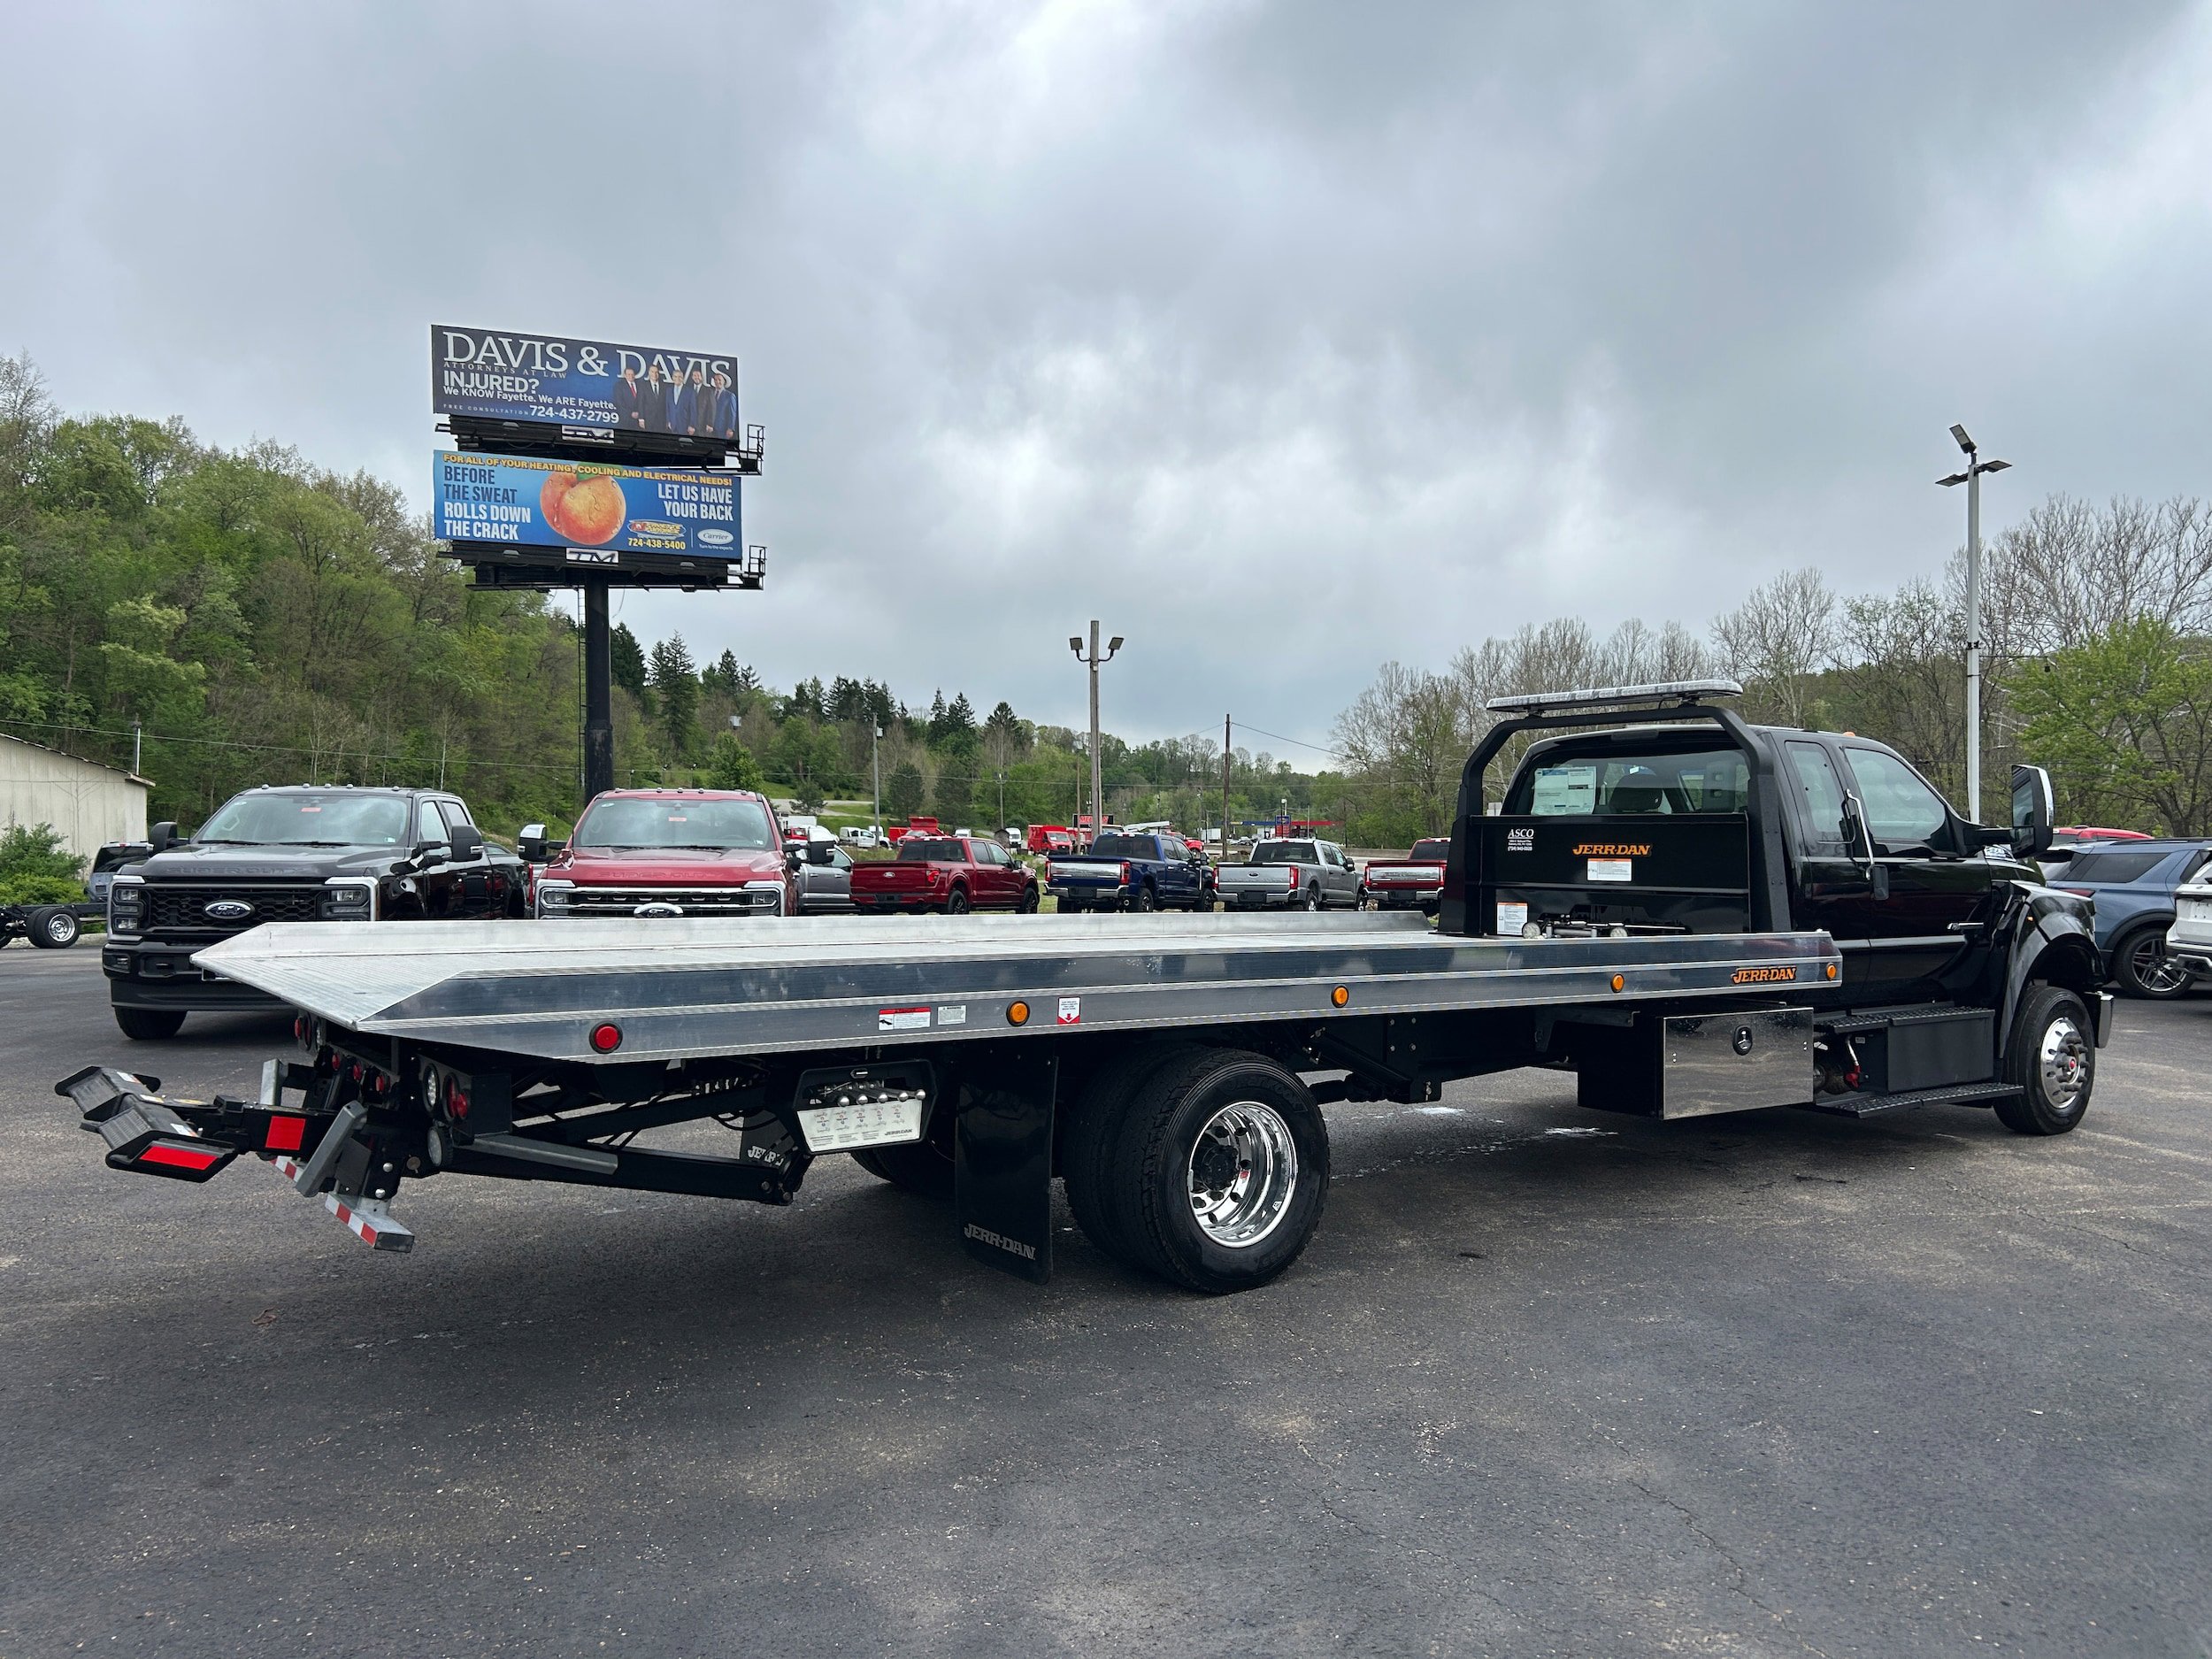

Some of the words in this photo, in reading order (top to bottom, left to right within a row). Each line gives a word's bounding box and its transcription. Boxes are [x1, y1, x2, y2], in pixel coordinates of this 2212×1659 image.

[442, 332, 568, 372] DAVIS
[577, 346, 609, 377] &
[616, 349, 732, 388] DAVIS
[443, 361, 515, 374] ATTORNEYS
[443, 370, 540, 395] INJURED?
[443, 385, 459, 396] We
[462, 388, 495, 398] KNOW
[497, 391, 536, 403] Fayette.
[538, 394, 553, 403] We
[556, 396, 576, 406] ARE
[578, 398, 617, 410] Fayette.
[529, 404, 619, 424] 724-437-2799
[443, 453, 465, 464] FOR
[465, 455, 485, 466] ALL
[486, 457, 500, 467] OF
[501, 459, 528, 469] YOUR
[577, 465, 620, 477] COOLING
[621, 469, 642, 479] AND
[643, 472, 698, 483] ELECTRICAL
[699, 476, 733, 486] NEEDS!
[444, 465, 495, 485] BEFORE
[443, 484, 469, 500] THE
[472, 486, 518, 504] SWEAT
[657, 482, 680, 500] LET
[681, 485, 699, 502] US
[700, 487, 733, 504] HAVE
[444, 501, 488, 519] ROLLS
[490, 504, 531, 524] DOWN
[664, 500, 697, 518] YOUR
[700, 504, 733, 522] BACK
[443, 519, 471, 537] THE
[472, 521, 518, 541] CRACK
[627, 537, 686, 550] 724-438-5400
[1508, 828, 1534, 838] ASCO
